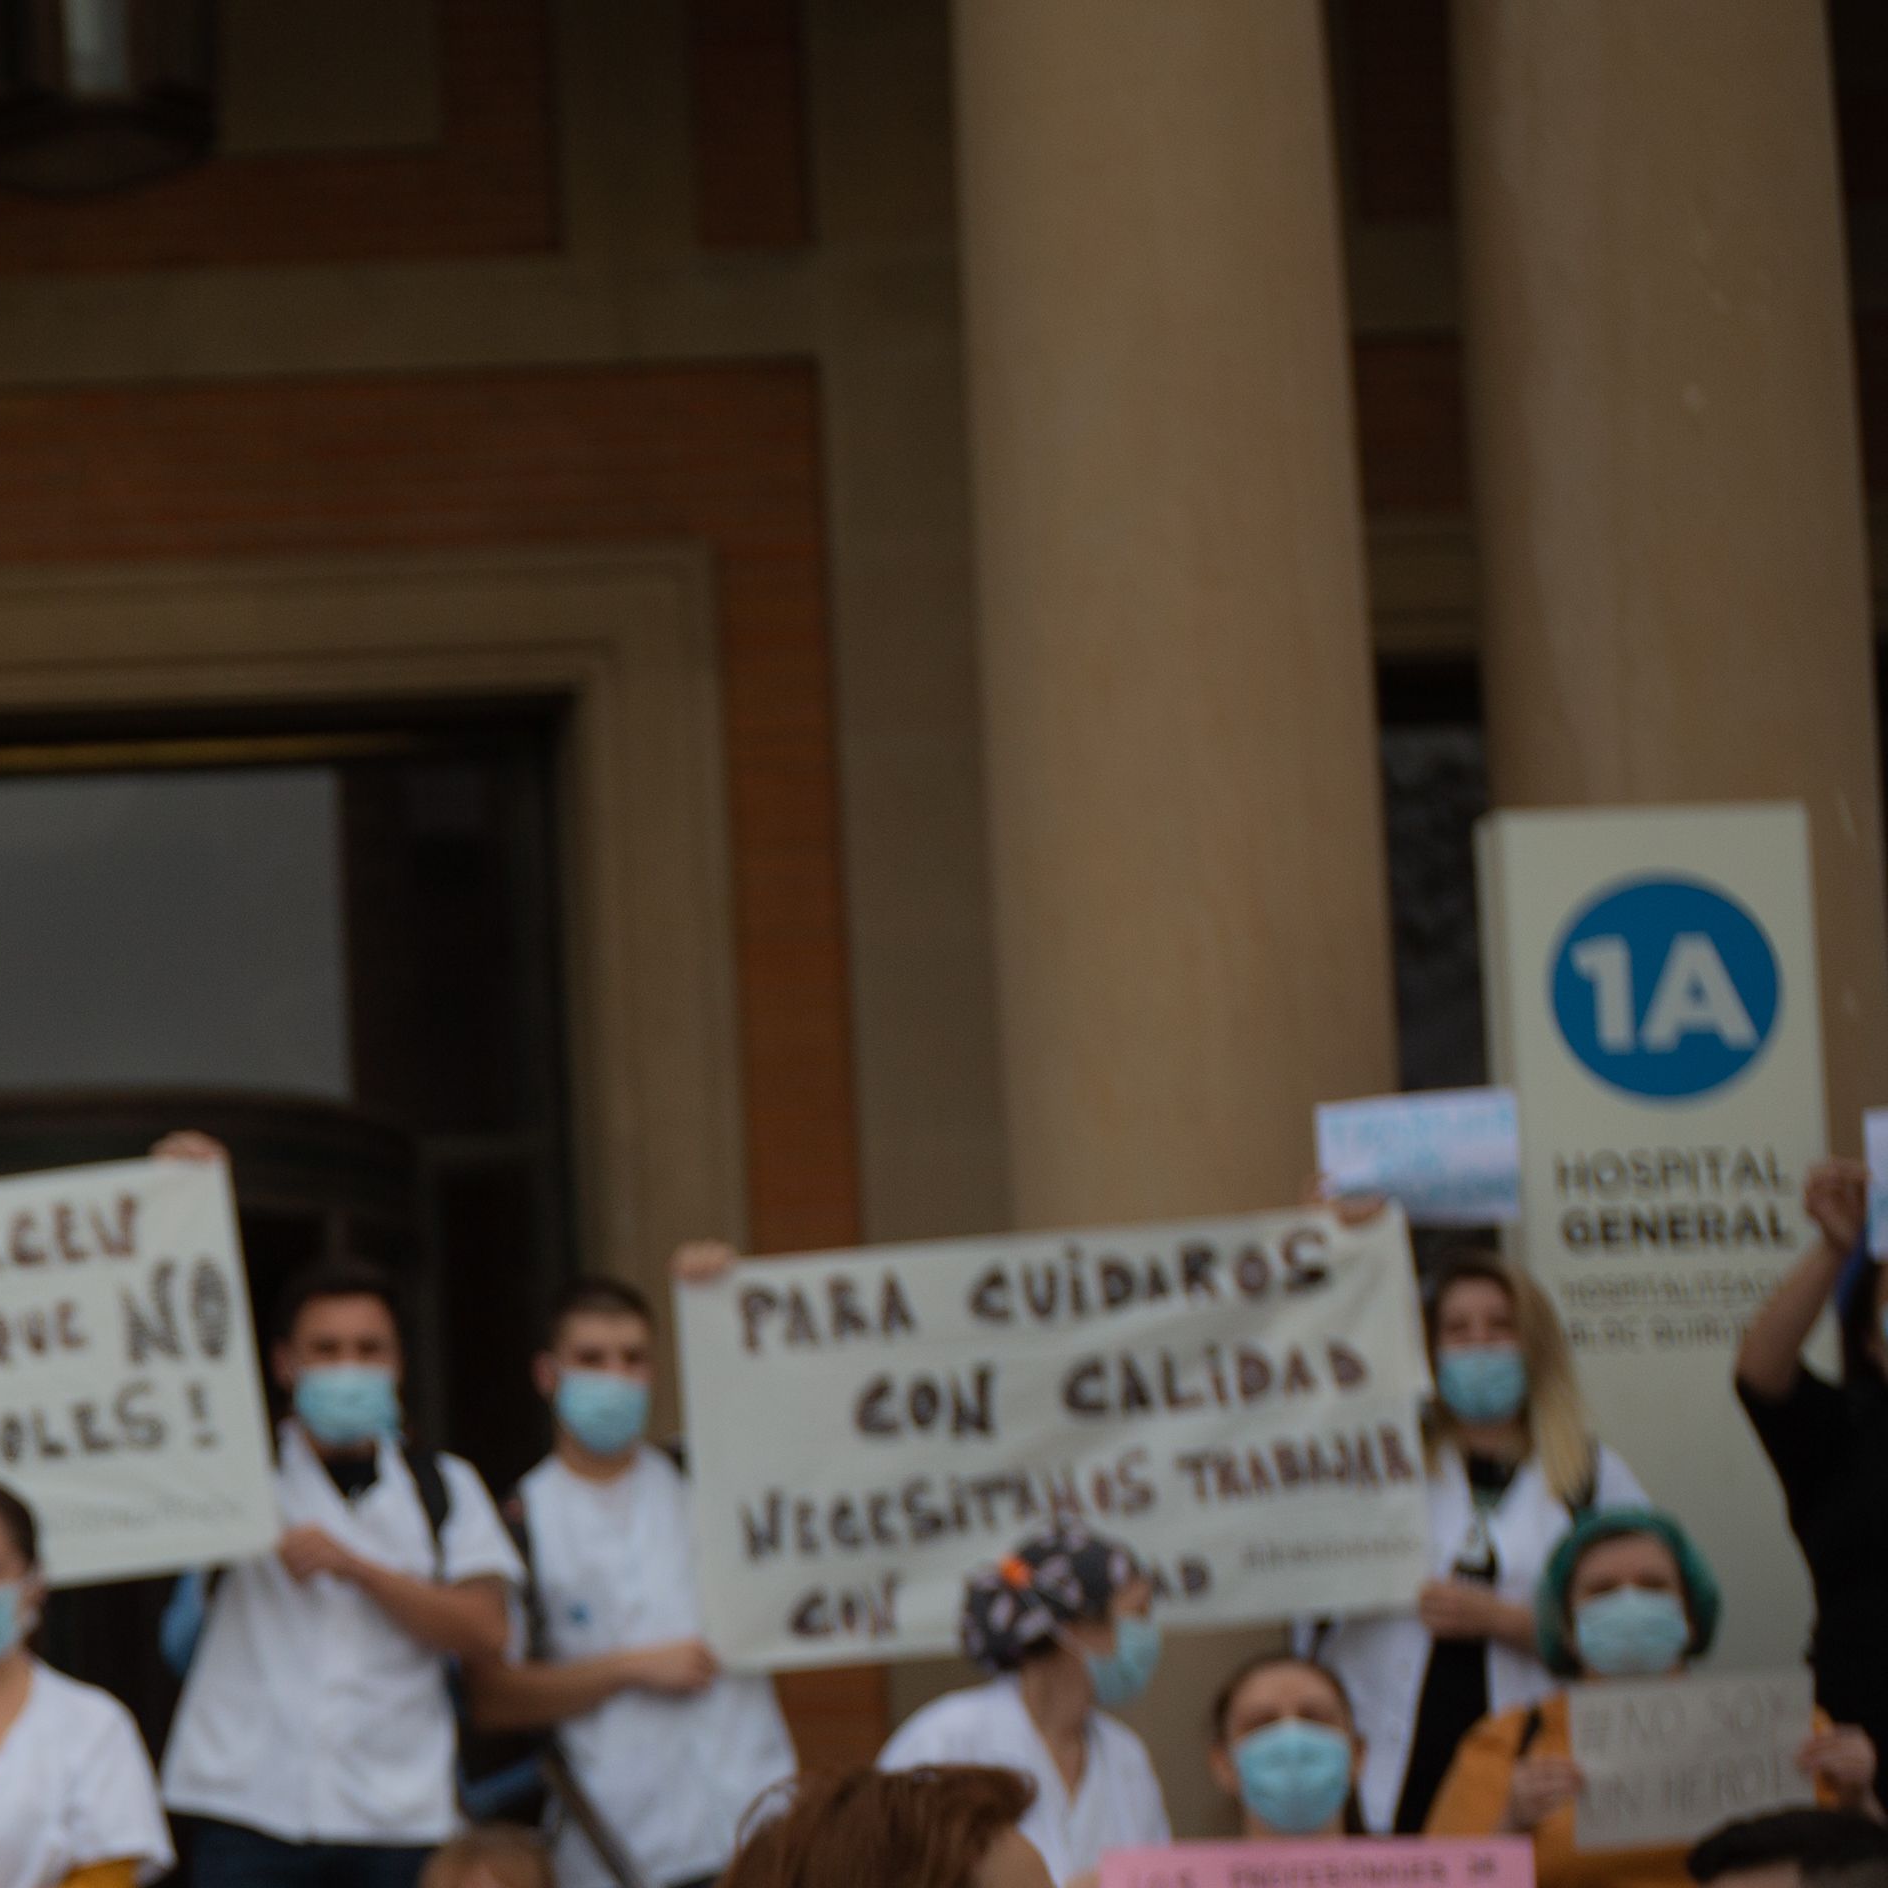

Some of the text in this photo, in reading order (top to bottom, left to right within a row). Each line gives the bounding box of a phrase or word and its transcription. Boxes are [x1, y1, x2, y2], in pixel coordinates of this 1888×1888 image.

[1569, 932, 1760, 1055] 1A
[1554, 1144, 1795, 1200] HOSPITAL
[1559, 1202, 1798, 1257] GENERAL
[123, 1257, 227, 1368] NO
[740, 1271, 916, 1356] PARA
[856, 1340, 1366, 1440] CON CALIDAD
